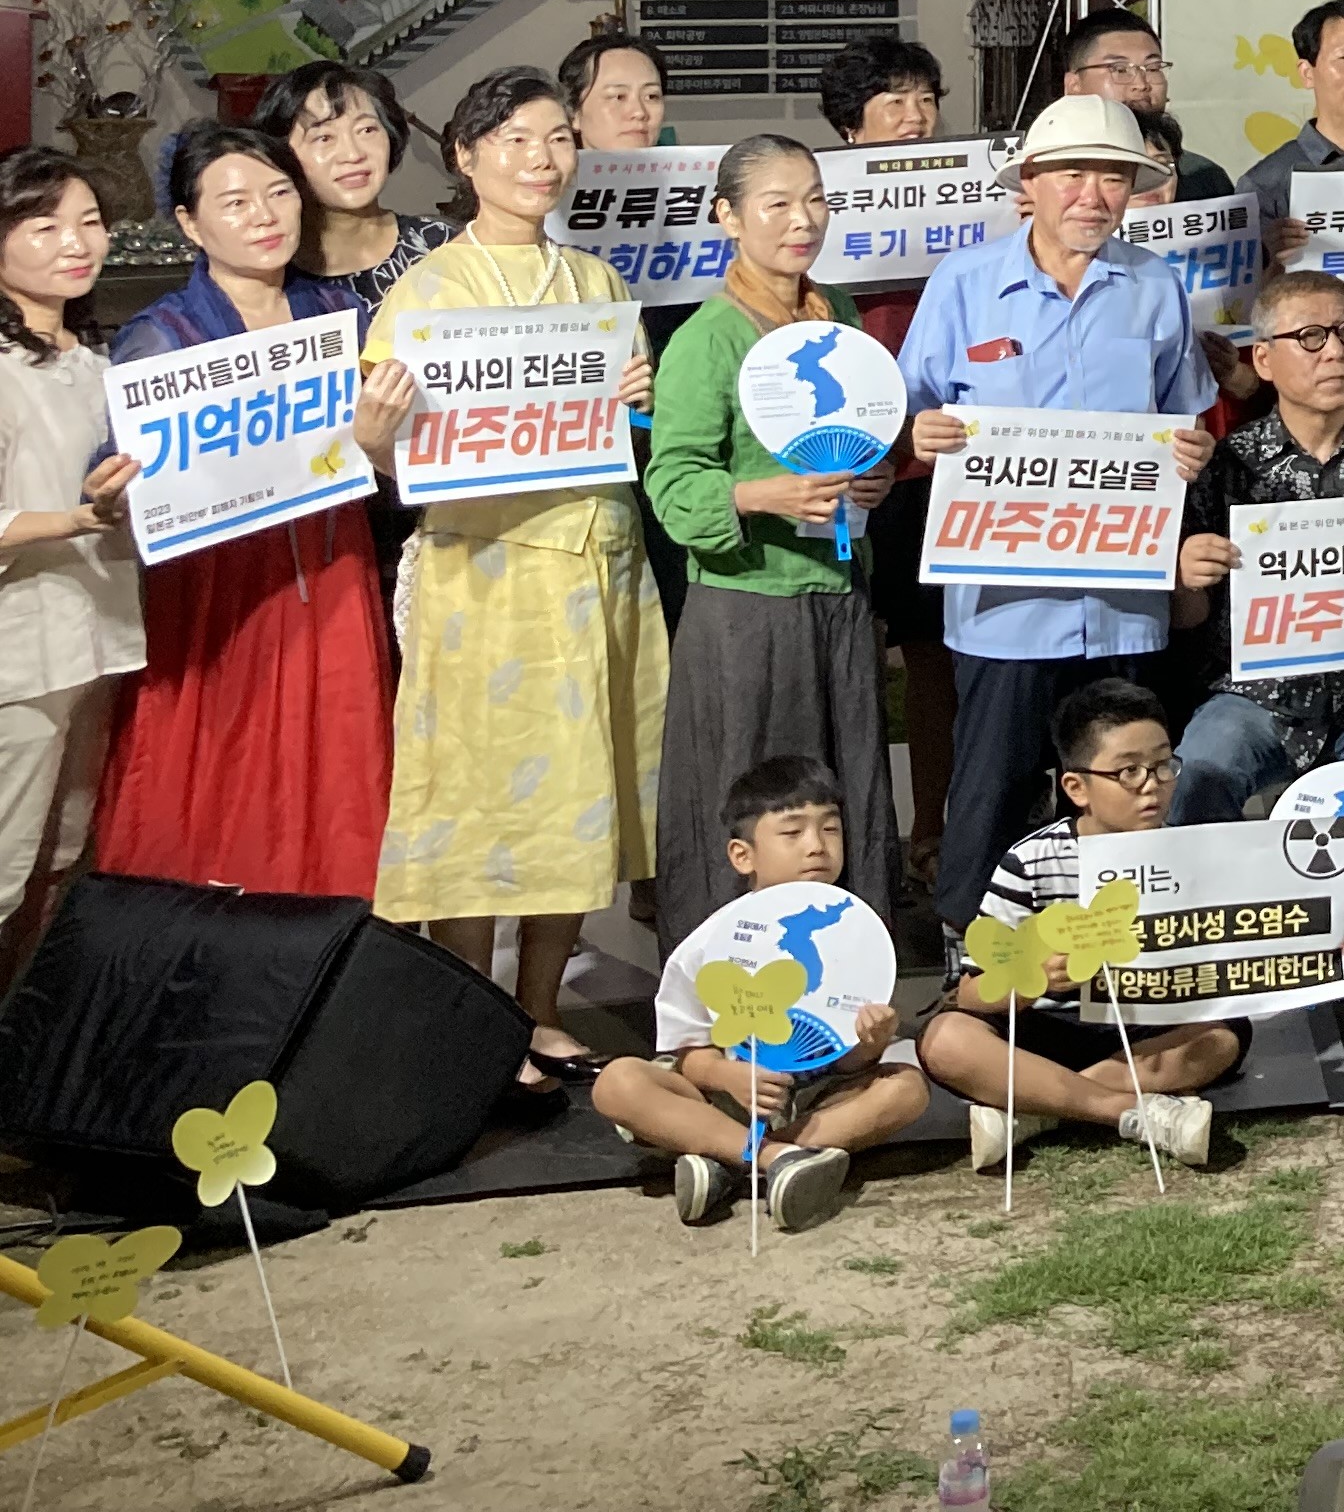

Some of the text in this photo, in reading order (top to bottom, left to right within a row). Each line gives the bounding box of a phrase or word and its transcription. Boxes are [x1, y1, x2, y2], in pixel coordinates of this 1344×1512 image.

[826, 180, 1007, 215] 후쿠시마 오염수
[844, 221, 985, 260] 투기 반대
[1183, 207, 1248, 236] 용기를
[122, 330, 344, 409] 피해자들의 용기를
[423, 350, 606, 395] 역사의 진실을
[140, 368, 356, 479] 기억하라!
[408, 397, 623, 466] 마주하라!
[965, 456, 1160, 491] 역사의 진실을
[143, 503, 171, 520] 2023
[935, 500, 1172, 556] 마주하라!
[1154, 909, 1225, 948] 방사성
[1234, 904, 1310, 936] 오염수
[1226, 953, 1335, 990] 반대한다!
